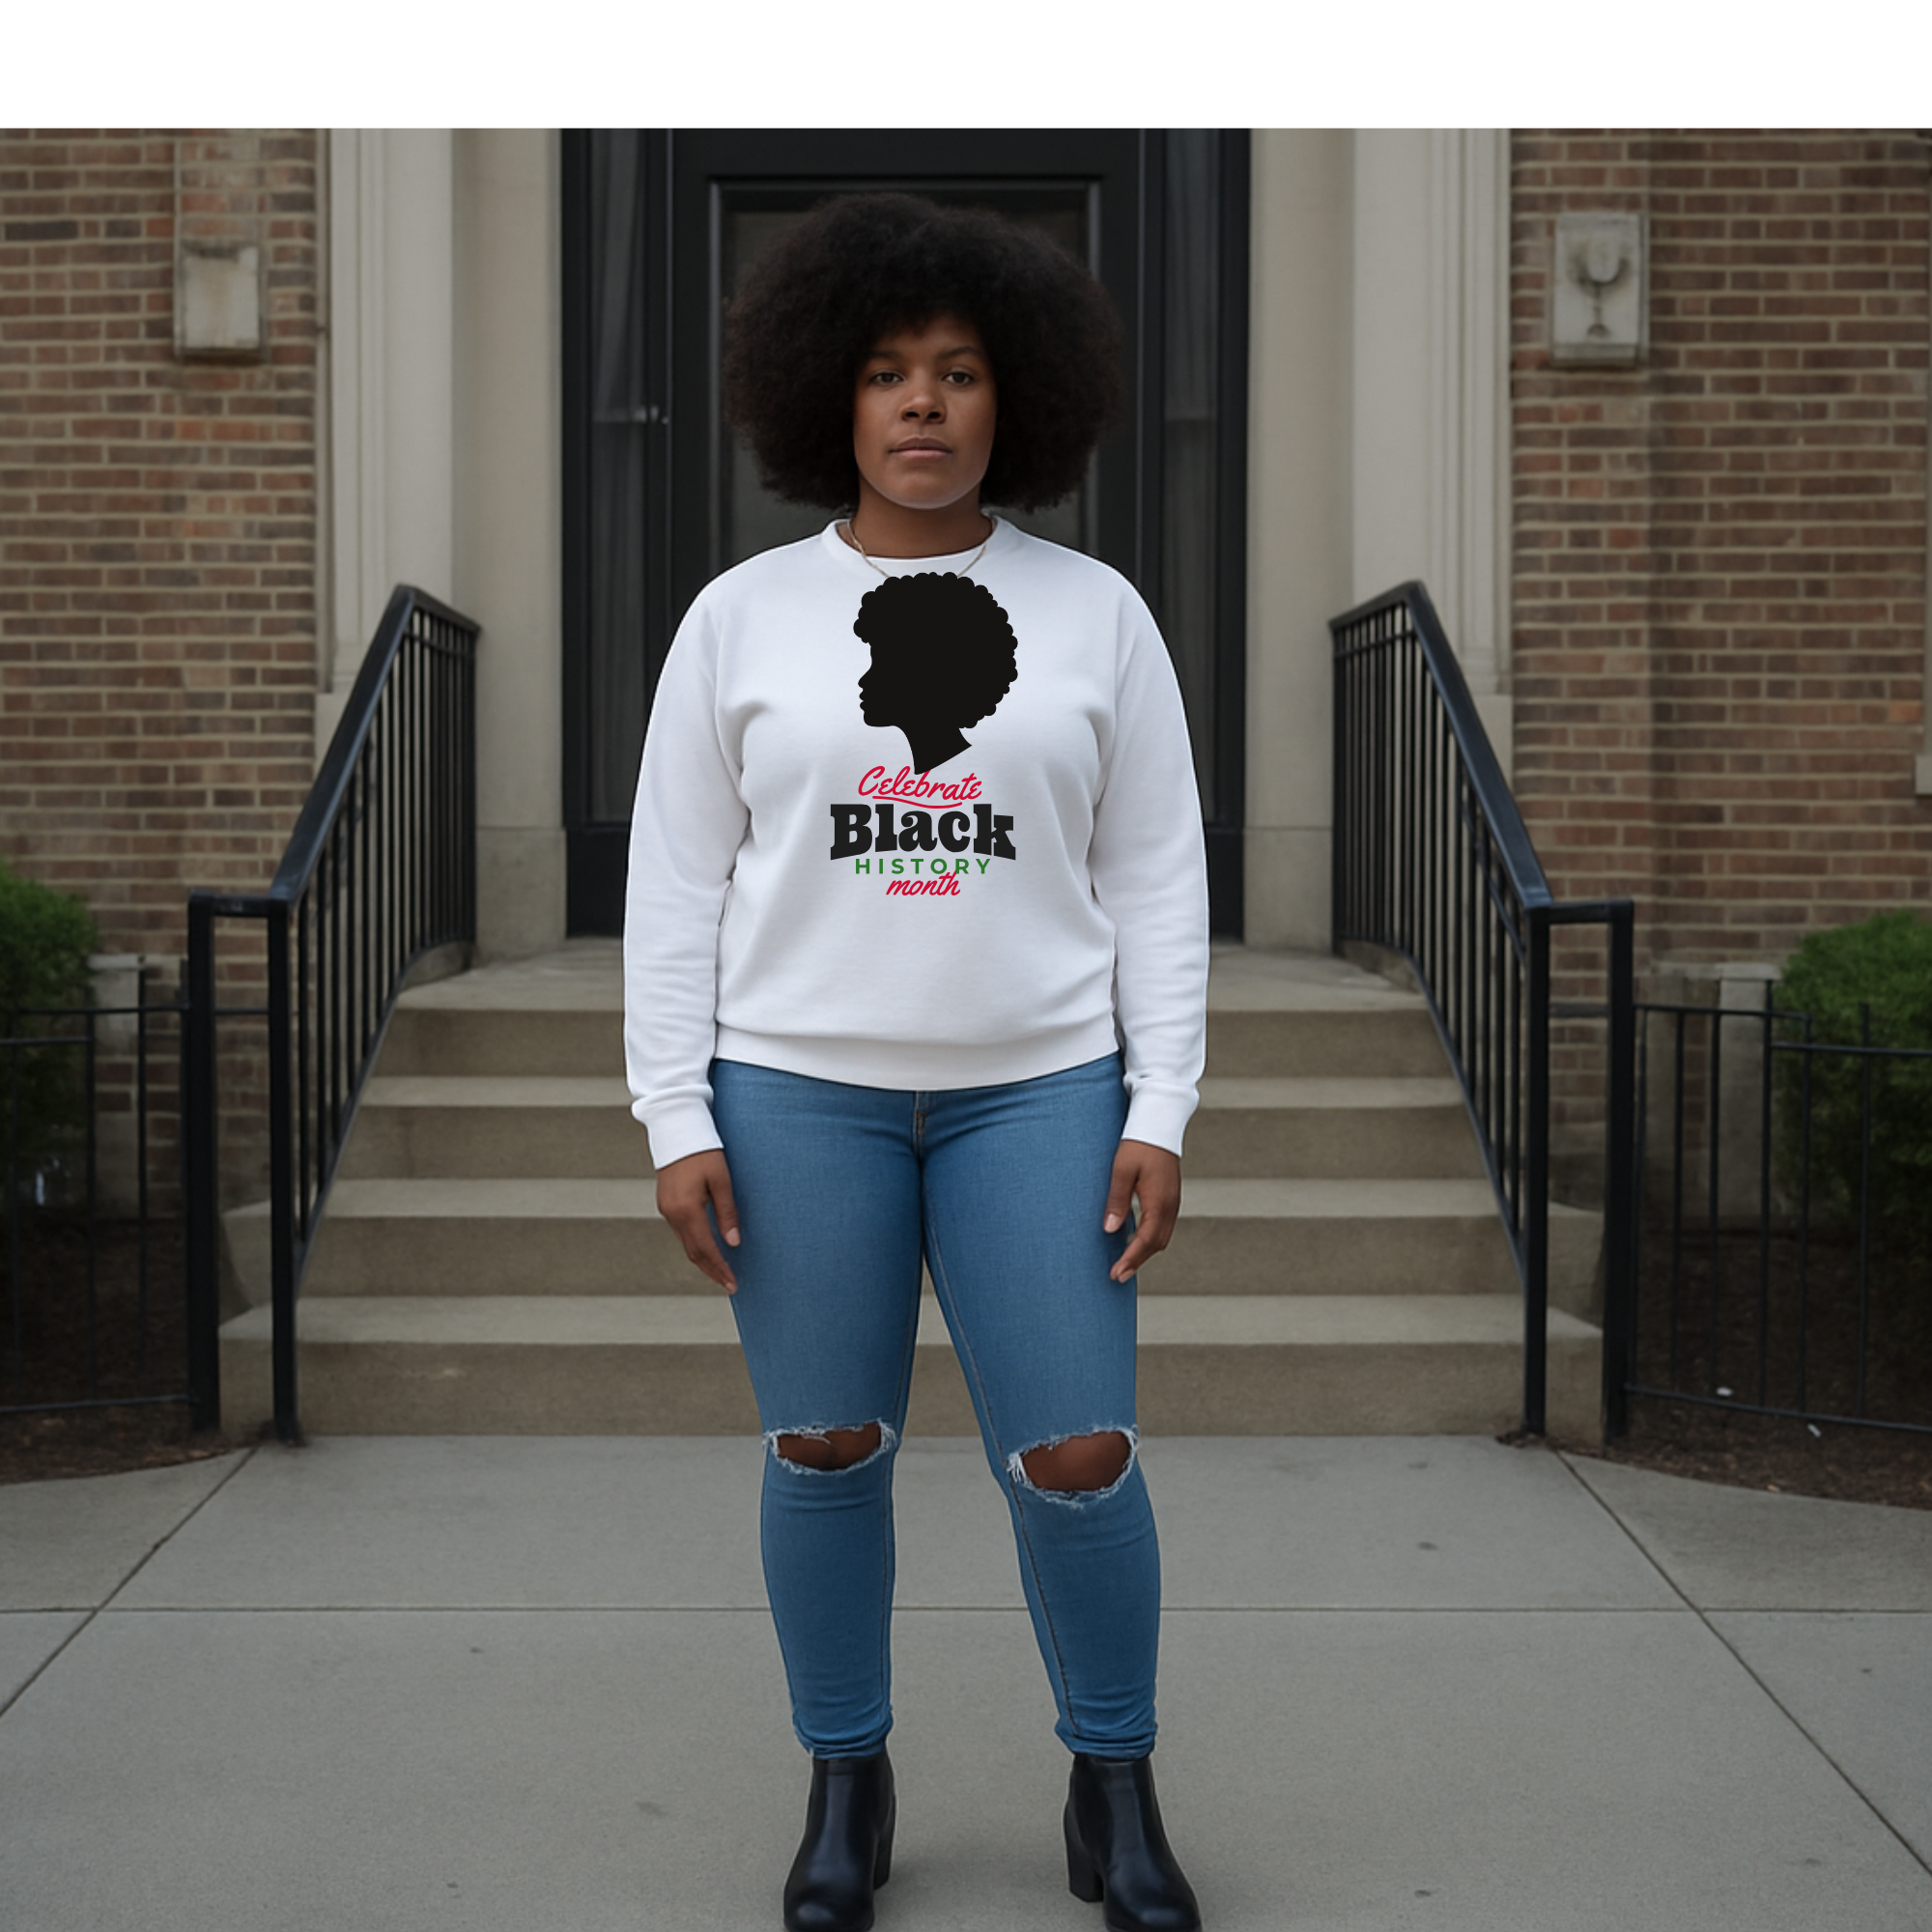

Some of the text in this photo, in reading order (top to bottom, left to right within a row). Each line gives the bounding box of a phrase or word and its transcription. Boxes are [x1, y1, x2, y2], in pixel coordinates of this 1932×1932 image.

[858, 765, 982, 800] Celebrate
[830, 804, 1016, 861] Black
[855, 858, 991, 875] HISTORY
[885, 869, 961, 896] month
